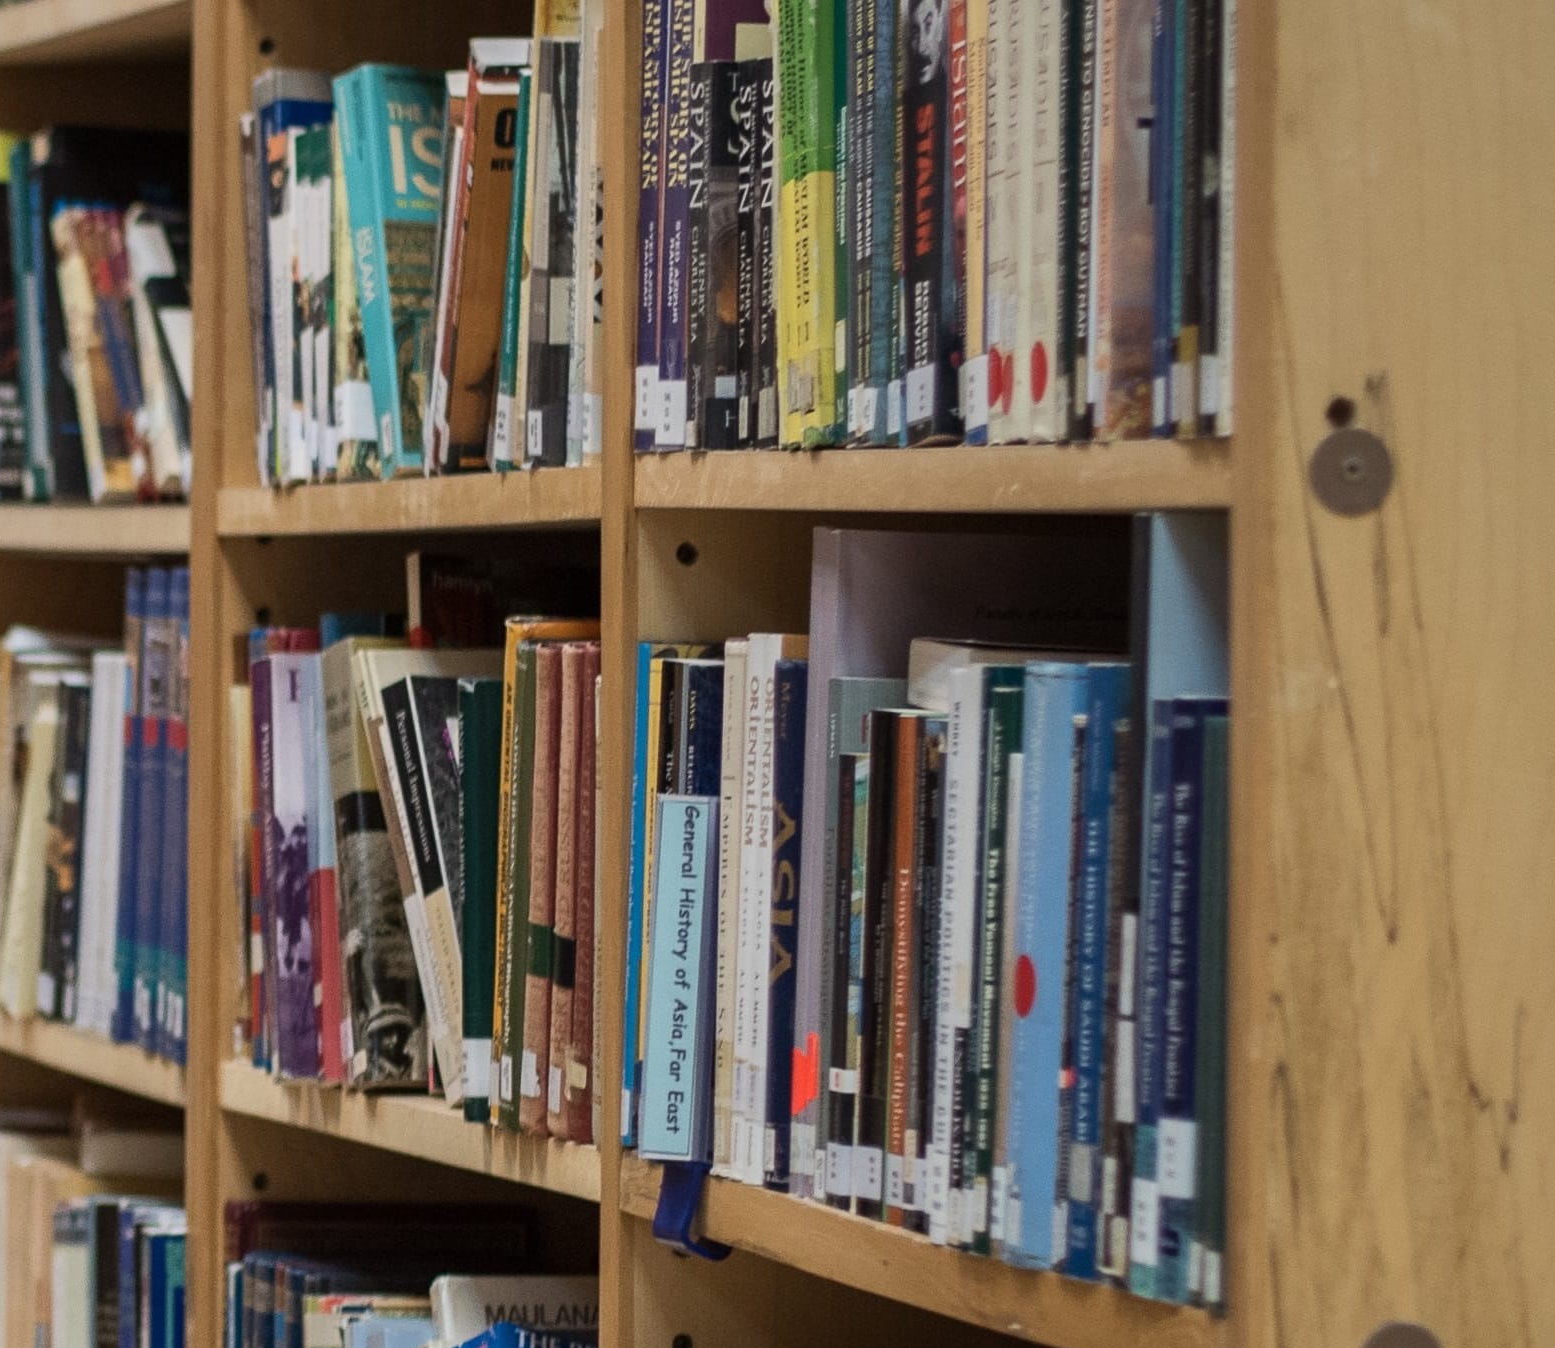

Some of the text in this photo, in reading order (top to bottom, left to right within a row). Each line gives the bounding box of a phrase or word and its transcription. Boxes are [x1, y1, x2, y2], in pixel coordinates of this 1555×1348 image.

[642, 4, 652, 190] ISLAMIC SPAIN
[649, 4, 660, 187] THE STORY OF
[668, 2, 682, 189] ISLAMIC SPAIN
[680, 60, 691, 141] STORY
[855, 59, 864, 95] ISLAM
[865, 55, 874, 92] ISLAM
[1082, 61, 1091, 84] TO
[679, 161, 689, 188] OF
[690, 82, 705, 210] SPAIN
[738, 86, 753, 214] SPAIN
[760, 80, 774, 209] SPAIN
[1080, 94, 1091, 192] GENOCIDE
[915, 105, 935, 257] STALIN
[355, 226, 376, 307] ISLAM
[691, 226, 699, 309] CHARLES
[738, 228, 746, 313] CHARLES
[800, 239, 810, 305] WORLD
[1076, 207, 1087, 338] ROY GUTMAN
[688, 691, 697, 732] DAVIS
[778, 681, 791, 742] Meyer
[394, 711, 433, 864] Personal Impressions
[665, 753, 676, 785] The
[1174, 783, 1189, 808] The
[681, 805, 701, 879] General
[721, 794, 732, 900] EMPIRES
[941, 778, 959, 902] SECTARIAN
[1086, 819, 1098, 856] THE
[1173, 813, 1188, 845] Rise
[770, 803, 796, 987] ASIA
[987, 848, 1000, 878] The
[1170, 871, 1186, 912] Islam
[672, 888, 698, 961] History
[985, 882, 999, 917] Free
[1082, 866, 1097, 957] HISTORY
[1170, 916, 1184, 945] and
[892, 866, 912, 1006] Demystifying
[938, 910, 955, 1026] POLITICS
[1168, 948, 1183, 974] the
[674, 968, 692, 988] of
[1081, 964, 1094, 991] OF
[1166, 979, 1183, 1031] Bengal
[717, 1006, 727, 1068] SAND
[893, 1011, 907, 1045] the
[936, 1034, 949, 1049] IN
[934, 1056, 948, 1094] THE
[1164, 1035, 1181, 1099] Frontier
[665, 1089, 686, 1136] East
